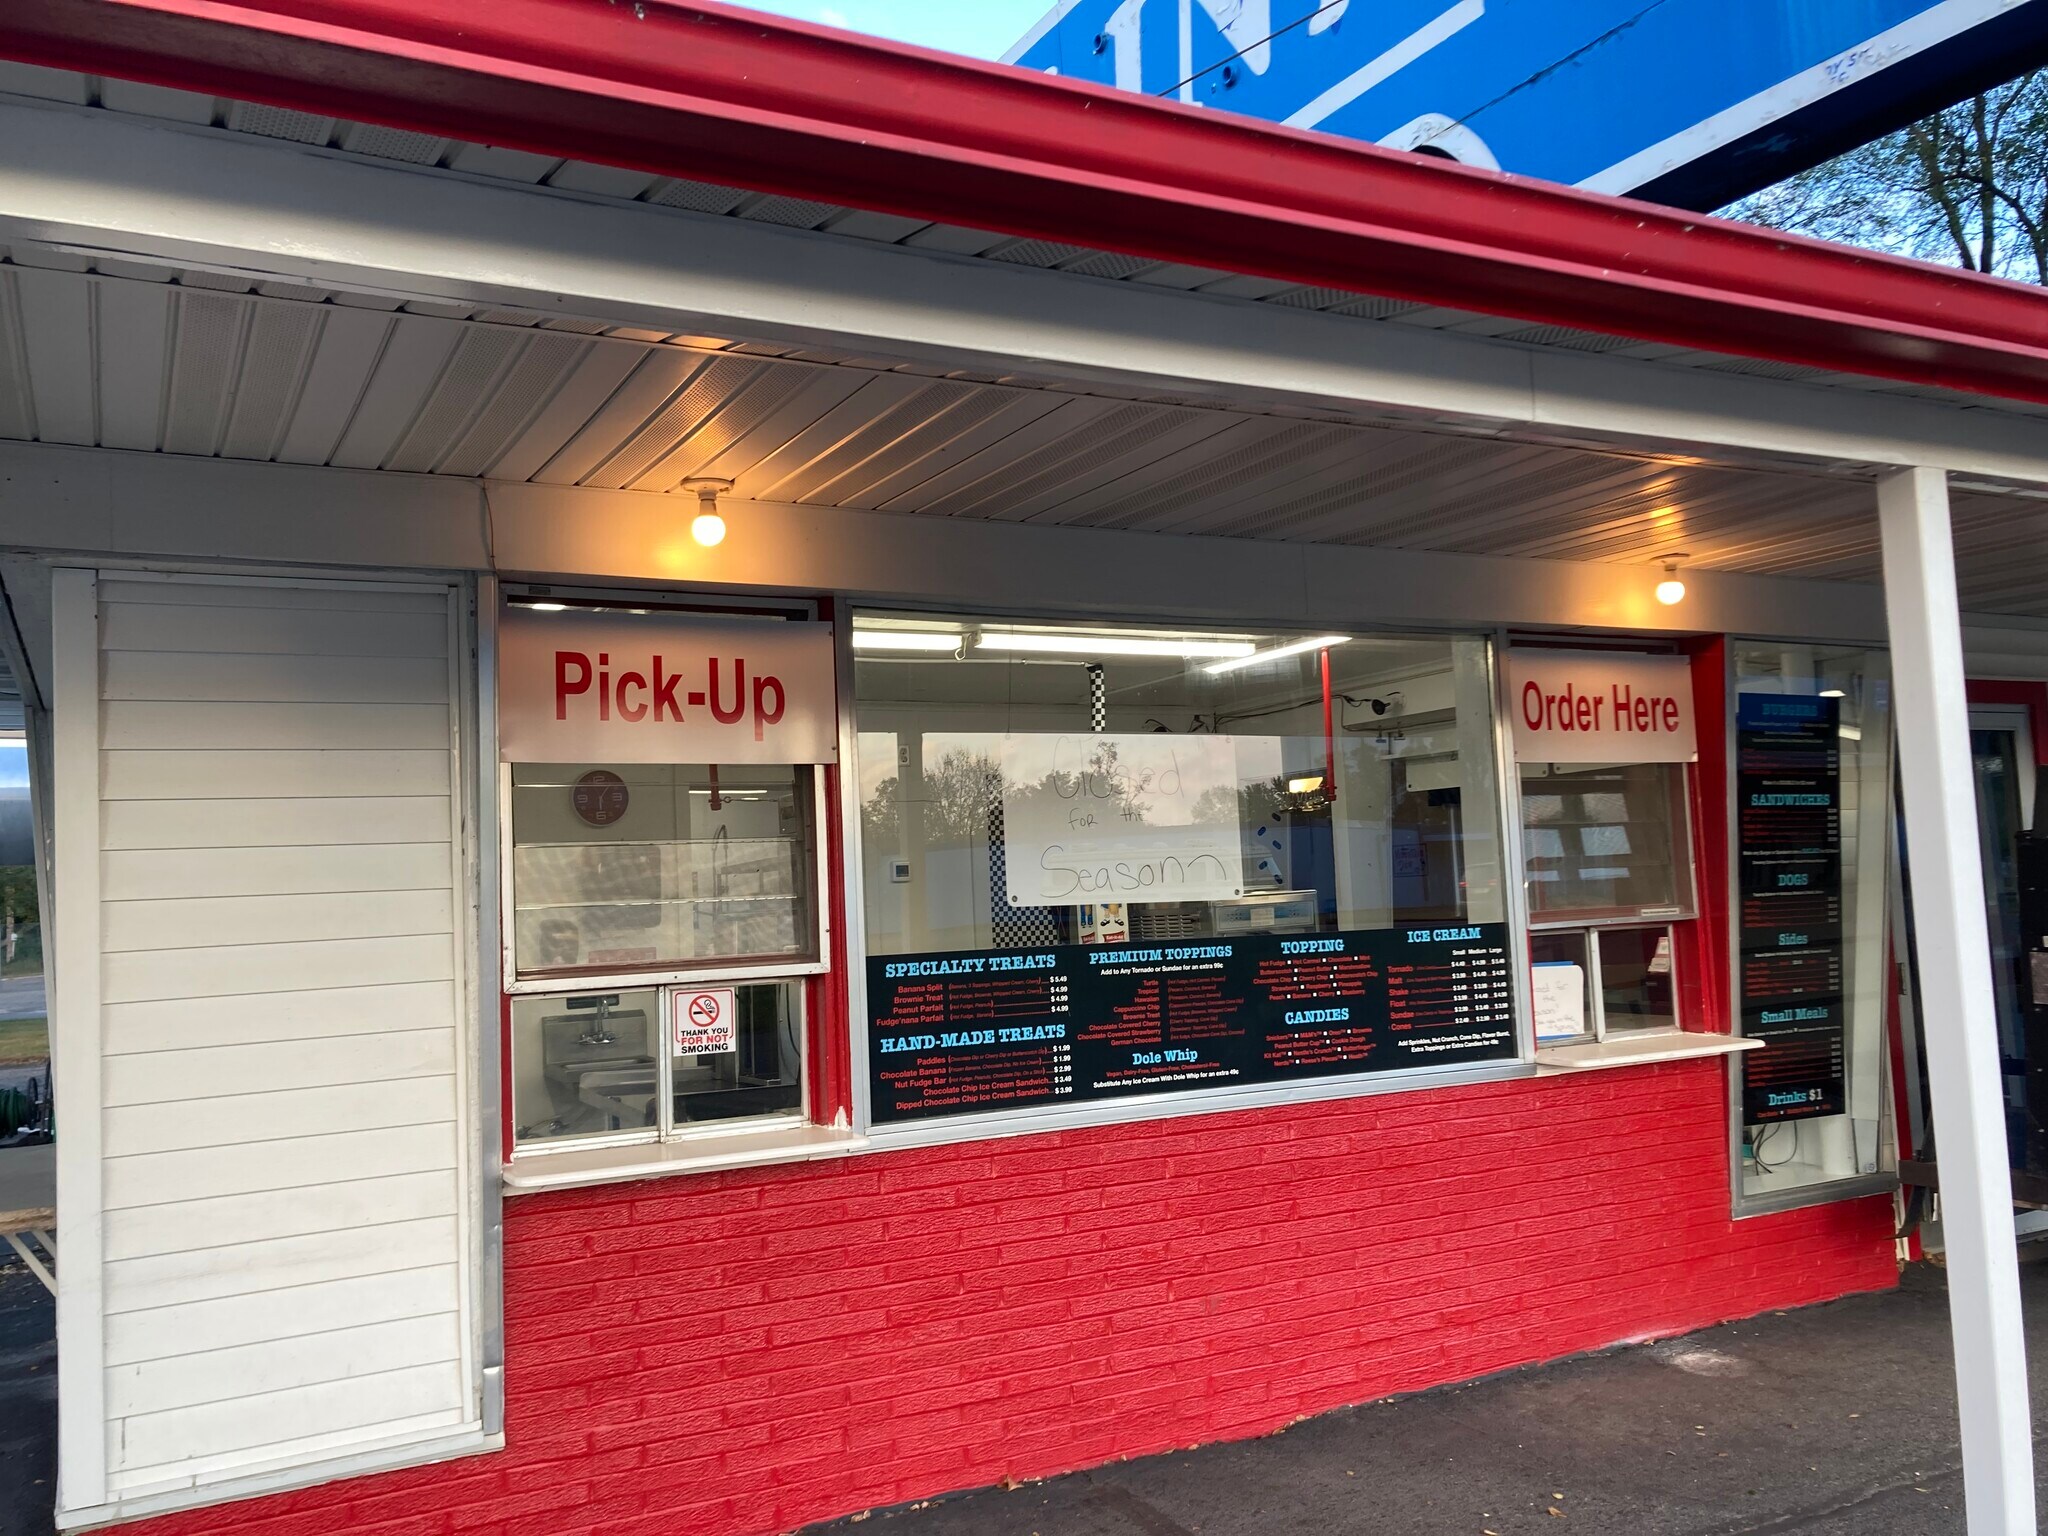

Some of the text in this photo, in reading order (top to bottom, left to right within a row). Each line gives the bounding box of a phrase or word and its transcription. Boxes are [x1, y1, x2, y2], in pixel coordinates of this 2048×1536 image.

[555, 650, 785, 742] Pick-Up
[1522, 681, 1679, 732] Order Here
[1751, 794, 1830, 805] SANDWICHES
[1778, 874, 1809, 886] DOGS
[1407, 928, 1481, 943] ICE CREAM
[1779, 933, 1808, 946] Sides
[1281, 939, 1344, 954] TOPPING
[1089, 946, 1232, 964] PREMIUM TOPPINGS
[886, 954, 1056, 977] SPECIALTY TREATS
[927, 984, 942, 992] Split
[920, 1004, 943, 1012] Parfait
[1285, 1008, 1349, 1024] CANDIES
[1761, 1007, 1828, 1024] Small Meals
[681, 1034, 728, 1045] FOR NOT
[880, 1024, 1065, 1052] HAND-MADE TREATS
[681, 1043, 728, 1054] SMOKING
[1132, 1048, 1198, 1065] Dole Whip
[881, 1070, 917, 1079] Chocolate
[1093, 1080, 1121, 1088] Substitute
[1142, 1076, 1160, 1084] Cream
[1186, 1072, 1199, 1080] Whip
[910, 1079, 932, 1087] Fudge
[924, 1087, 959, 1096] Chocolate
[961, 1082, 977, 1092] Chip
[979, 1081, 989, 1089] Ice
[992, 1079, 1014, 1089] Cream
[896, 1101, 922, 1110] Dipped
[924, 1097, 960, 1106] Chocolate
[962, 1092, 978, 1103] Chip
[980, 1091, 990, 1100] Ice
[992, 1090, 1014, 1099] Cream
[1768, 1088, 1823, 1106] Drinks $1
